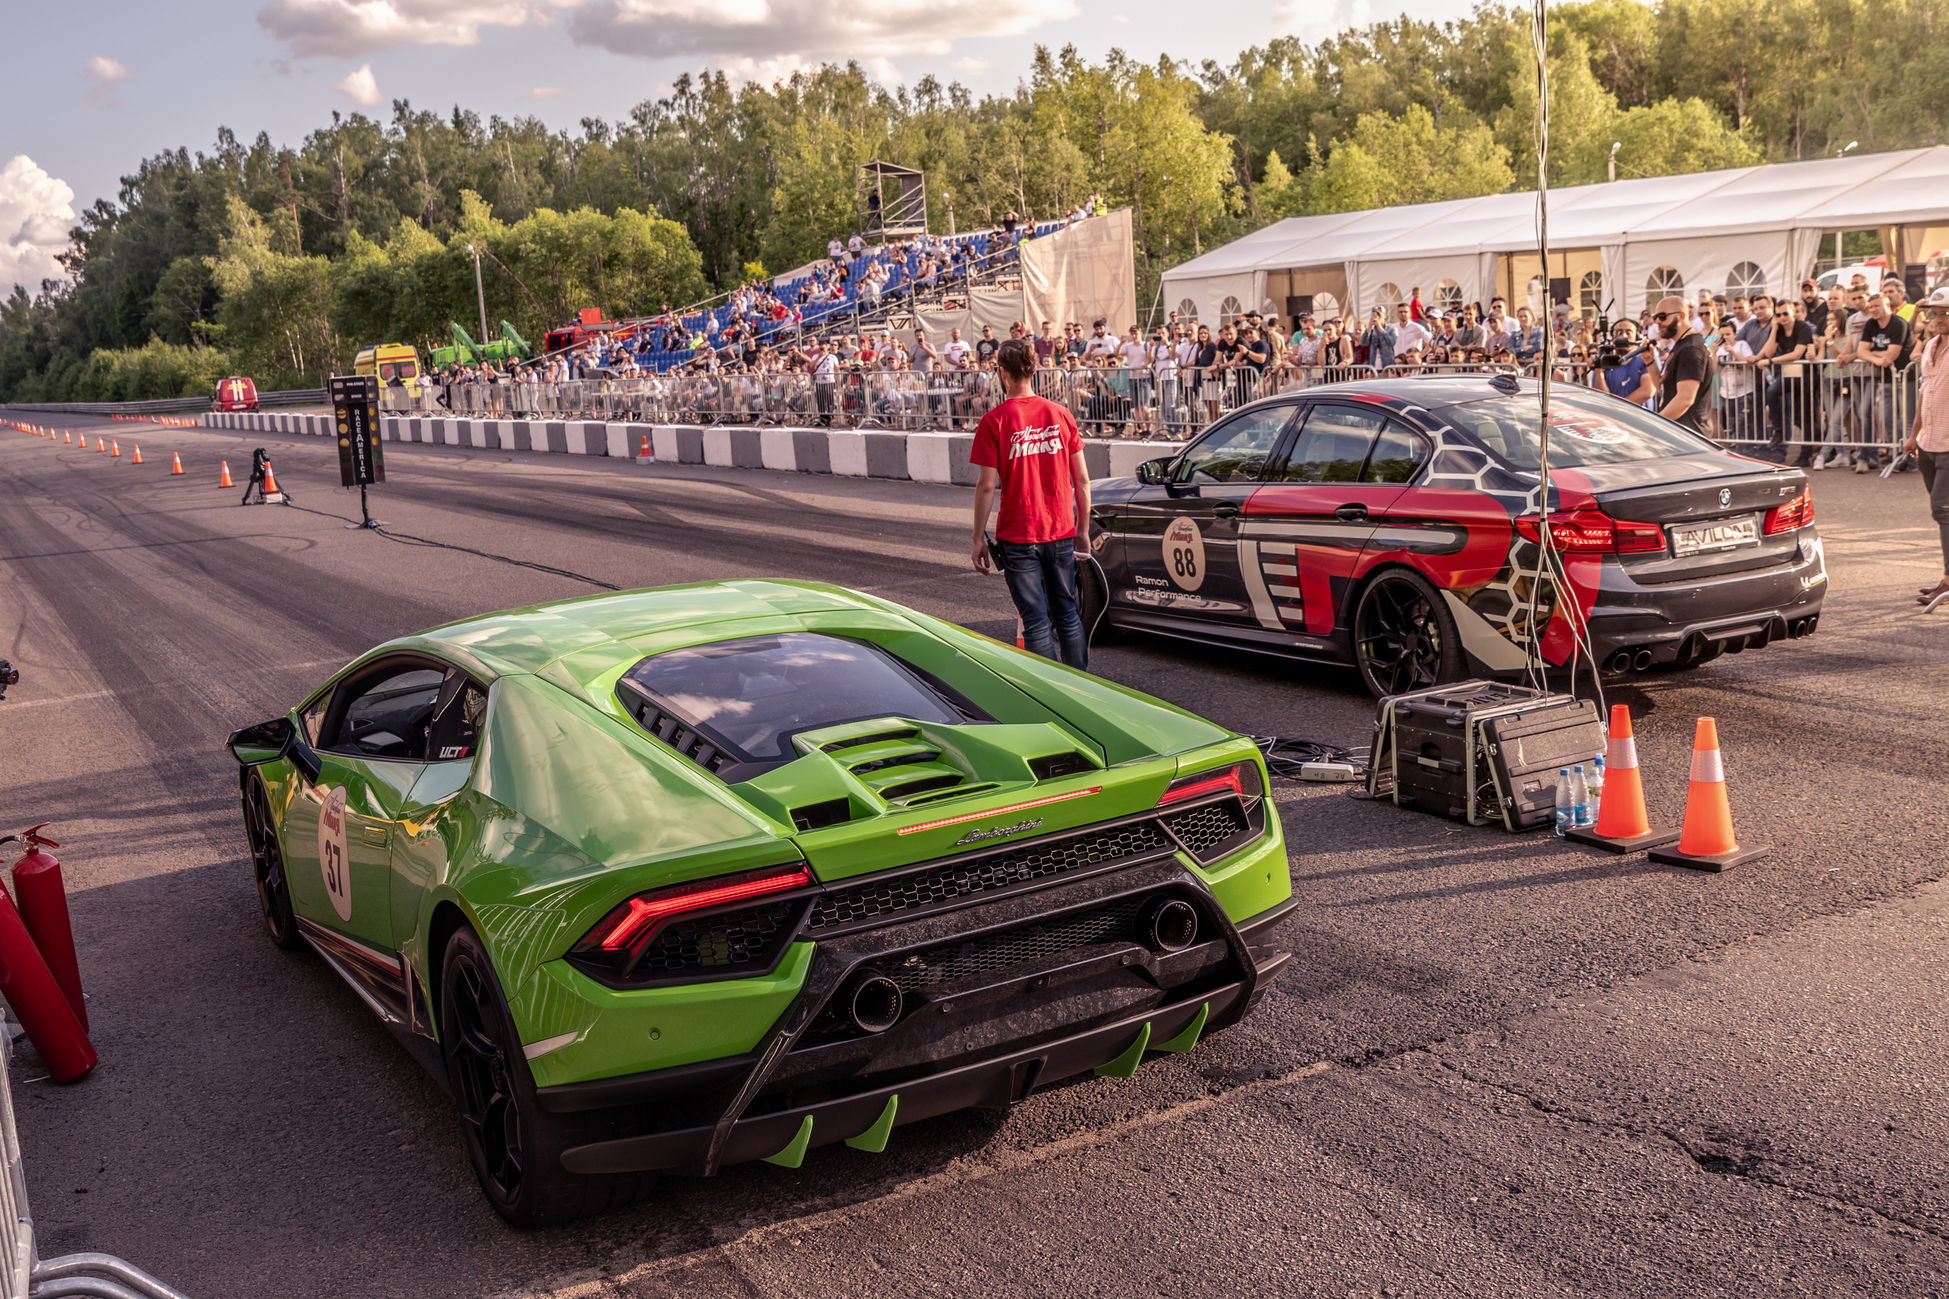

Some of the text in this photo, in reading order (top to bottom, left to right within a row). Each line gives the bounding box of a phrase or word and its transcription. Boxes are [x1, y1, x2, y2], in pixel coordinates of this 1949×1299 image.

[1173, 547, 1196, 577] 88
[1135, 575, 1169, 587] Ramon
[1138, 587, 1202, 601] Performance
[956, 817, 1045, 846] Lamborghini
[325, 839, 344, 898] 37
